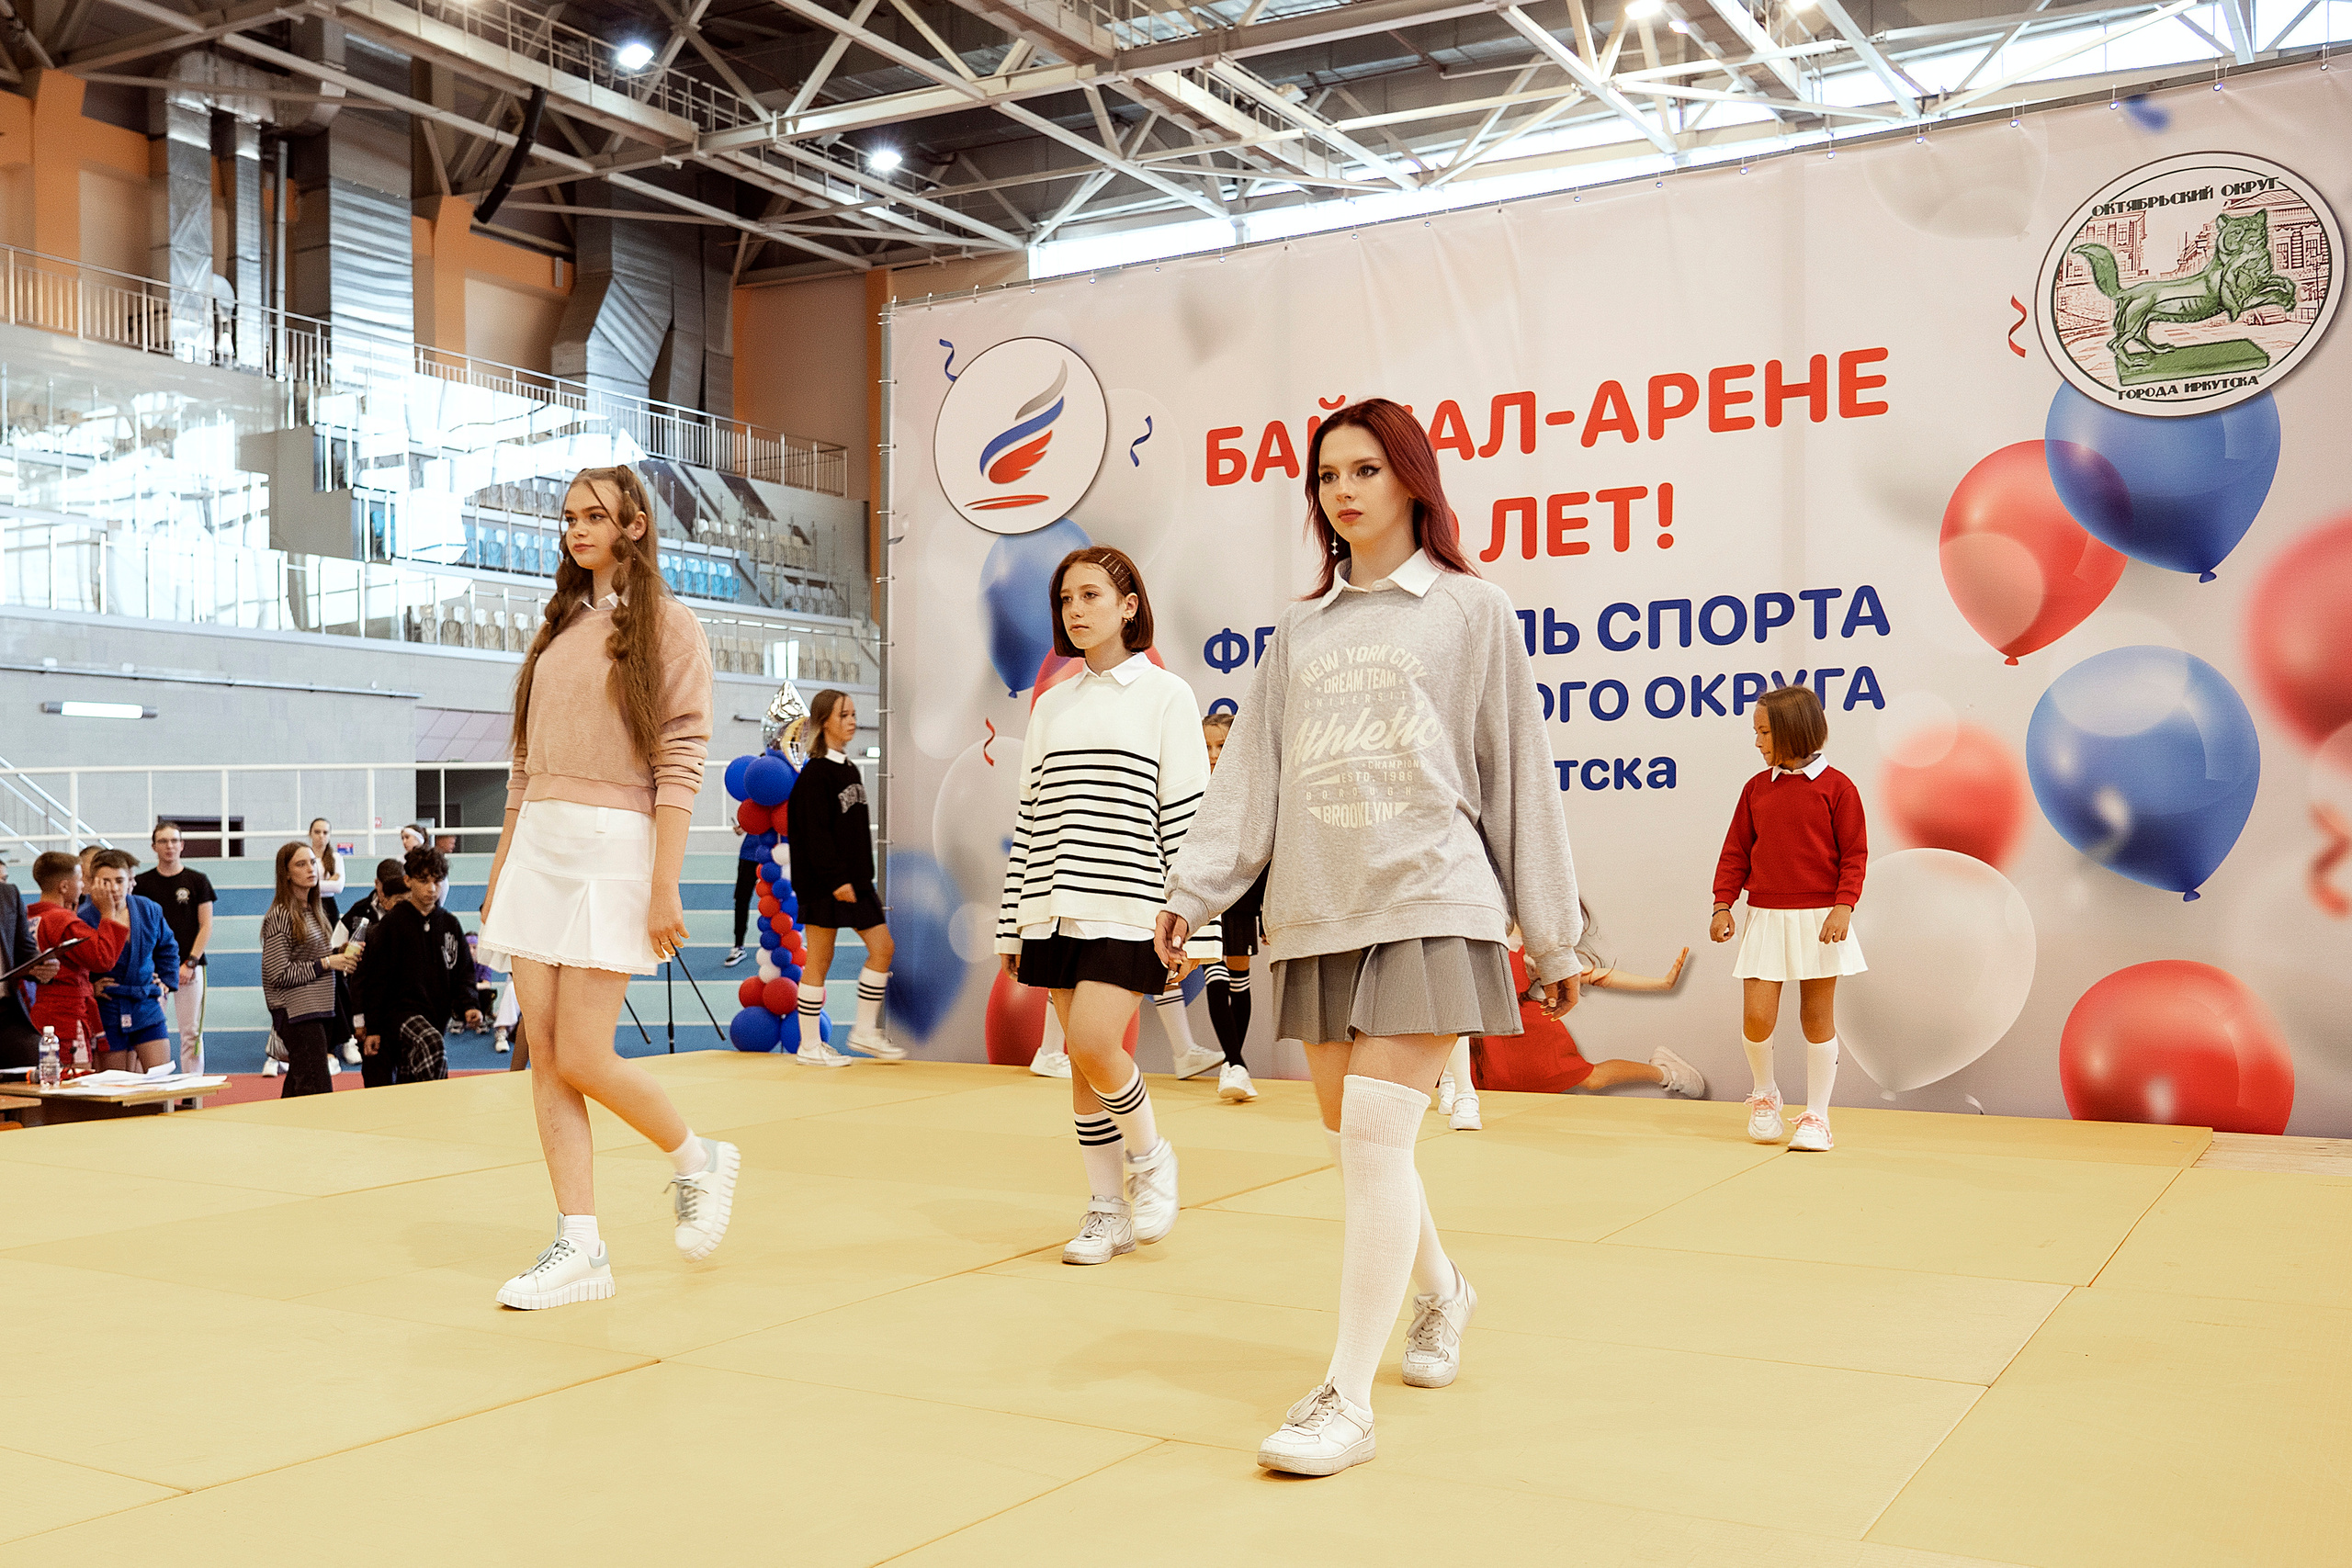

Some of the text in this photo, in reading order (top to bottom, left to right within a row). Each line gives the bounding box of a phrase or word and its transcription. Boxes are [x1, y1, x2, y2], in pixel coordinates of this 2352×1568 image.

[2092, 176, 2278, 217] ОКТЯБРЬСКИЙ ОКРУГ
[2118, 376, 2259, 400] ГОРОДА ИРКУТСКА
[1206, 347, 1889, 487] БААЛ-АРЕНЕ
[1479, 482, 1675, 563] ЛЕТ!
[1597, 585, 1891, 652] СПОРТА
[1300, 650, 1340, 688] NEW
[1345, 644, 1391, 664] YORK
[1389, 648, 1428, 681] CITY
[1324, 668, 1396, 694] DREAM TEAM
[1286, 700, 1443, 768] Athletic
[1306, 786, 1411, 801] BOROUGH
[1323, 801, 1394, 829] BROOKLYN
